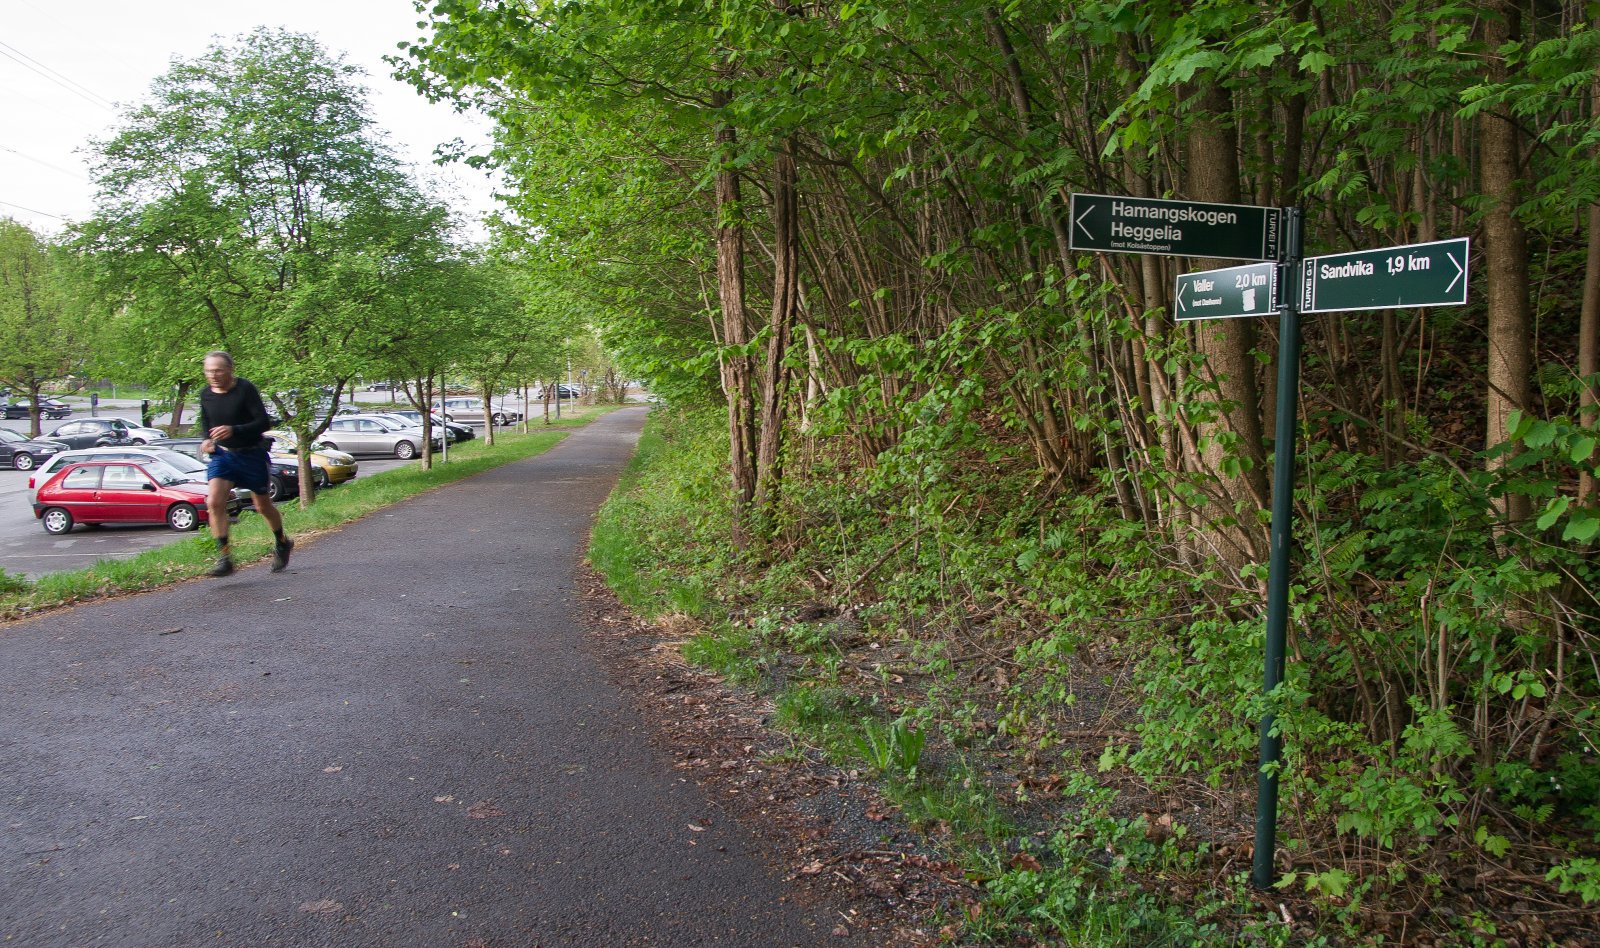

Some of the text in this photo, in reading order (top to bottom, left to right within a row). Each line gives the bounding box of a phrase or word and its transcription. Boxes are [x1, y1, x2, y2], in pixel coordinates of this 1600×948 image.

[1111, 201, 1237, 225] Hamangskogen
[1110, 221, 1182, 241] Heggelia
[1268, 212, 1277, 258] TURVEI F-1
[1110, 240, 1126, 248] (mot
[1320, 254, 1430, 280] Sandvika 1,9 km
[1193, 272, 1267, 293] Valler 2,0 km
[1304, 278, 1312, 309] TURVEI
